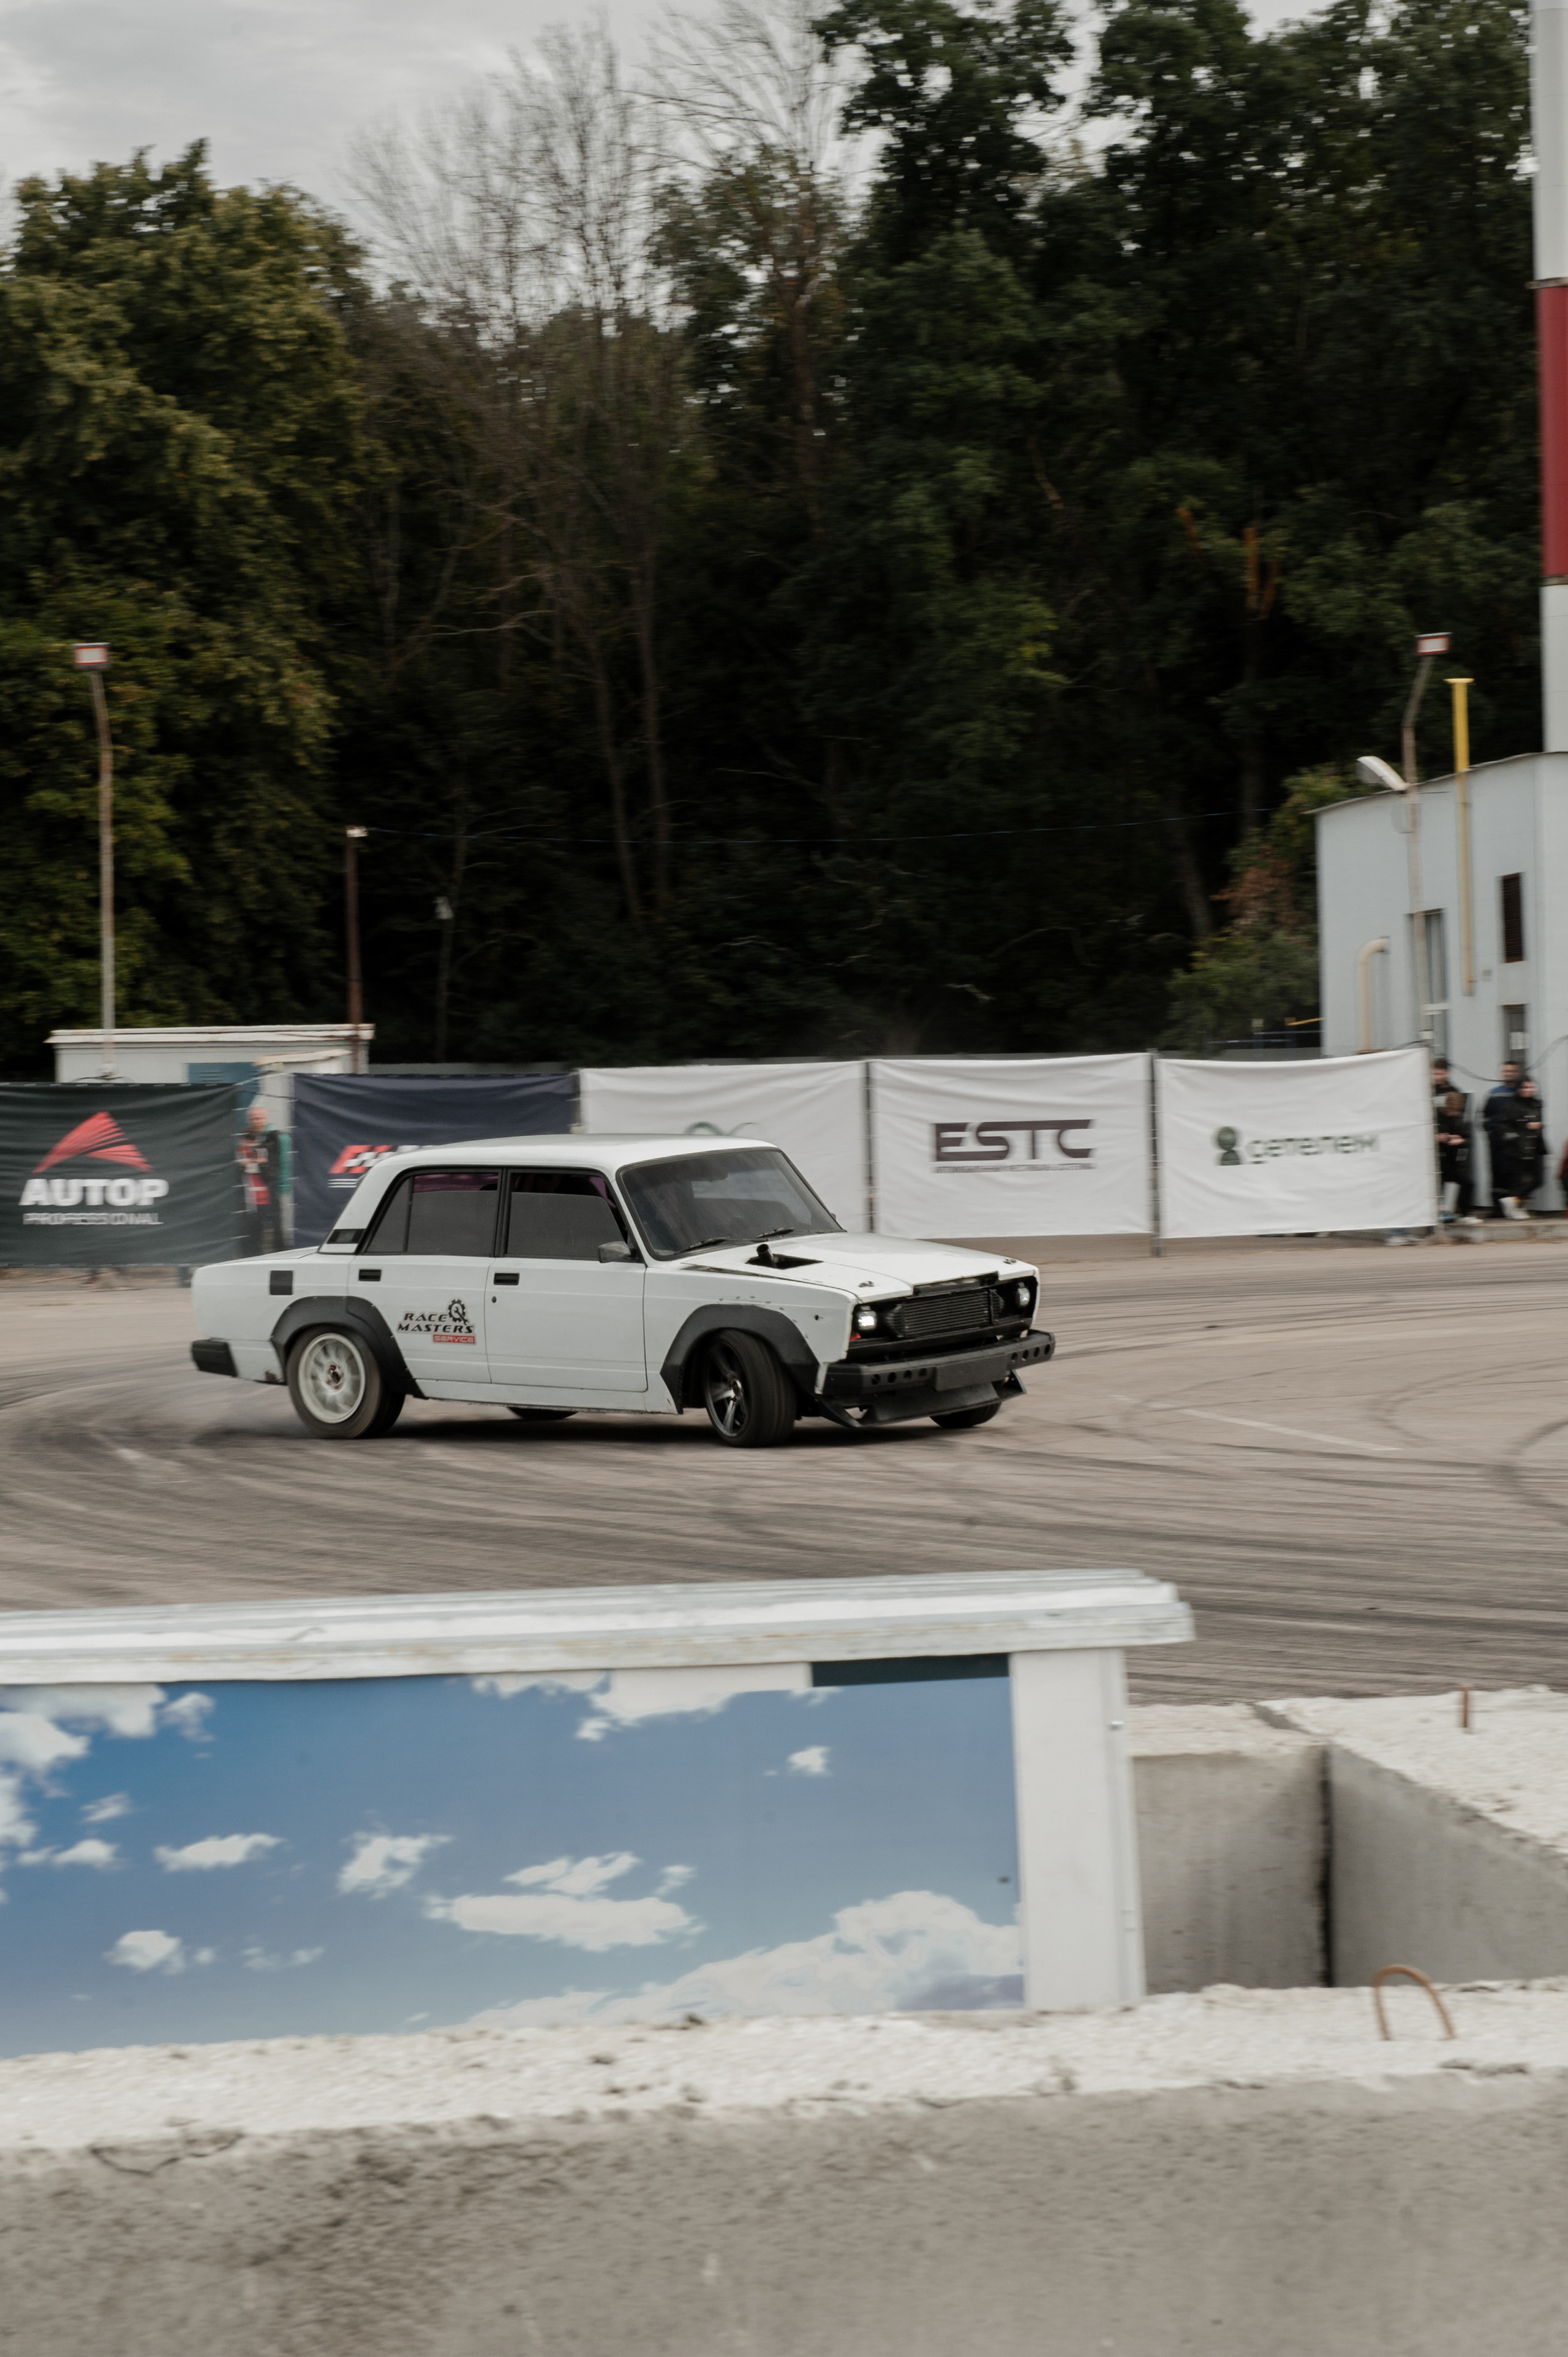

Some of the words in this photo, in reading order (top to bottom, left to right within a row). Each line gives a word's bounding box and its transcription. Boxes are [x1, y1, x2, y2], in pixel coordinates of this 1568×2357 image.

[930, 1119, 1097, 1162] ESTC
[19, 1178, 169, 1206] AUTOP
[23, 1213, 164, 1225] PROFESSIONAL
[404, 1313, 448, 1322] RACE
[398, 1323, 473, 1334] MASTERS
